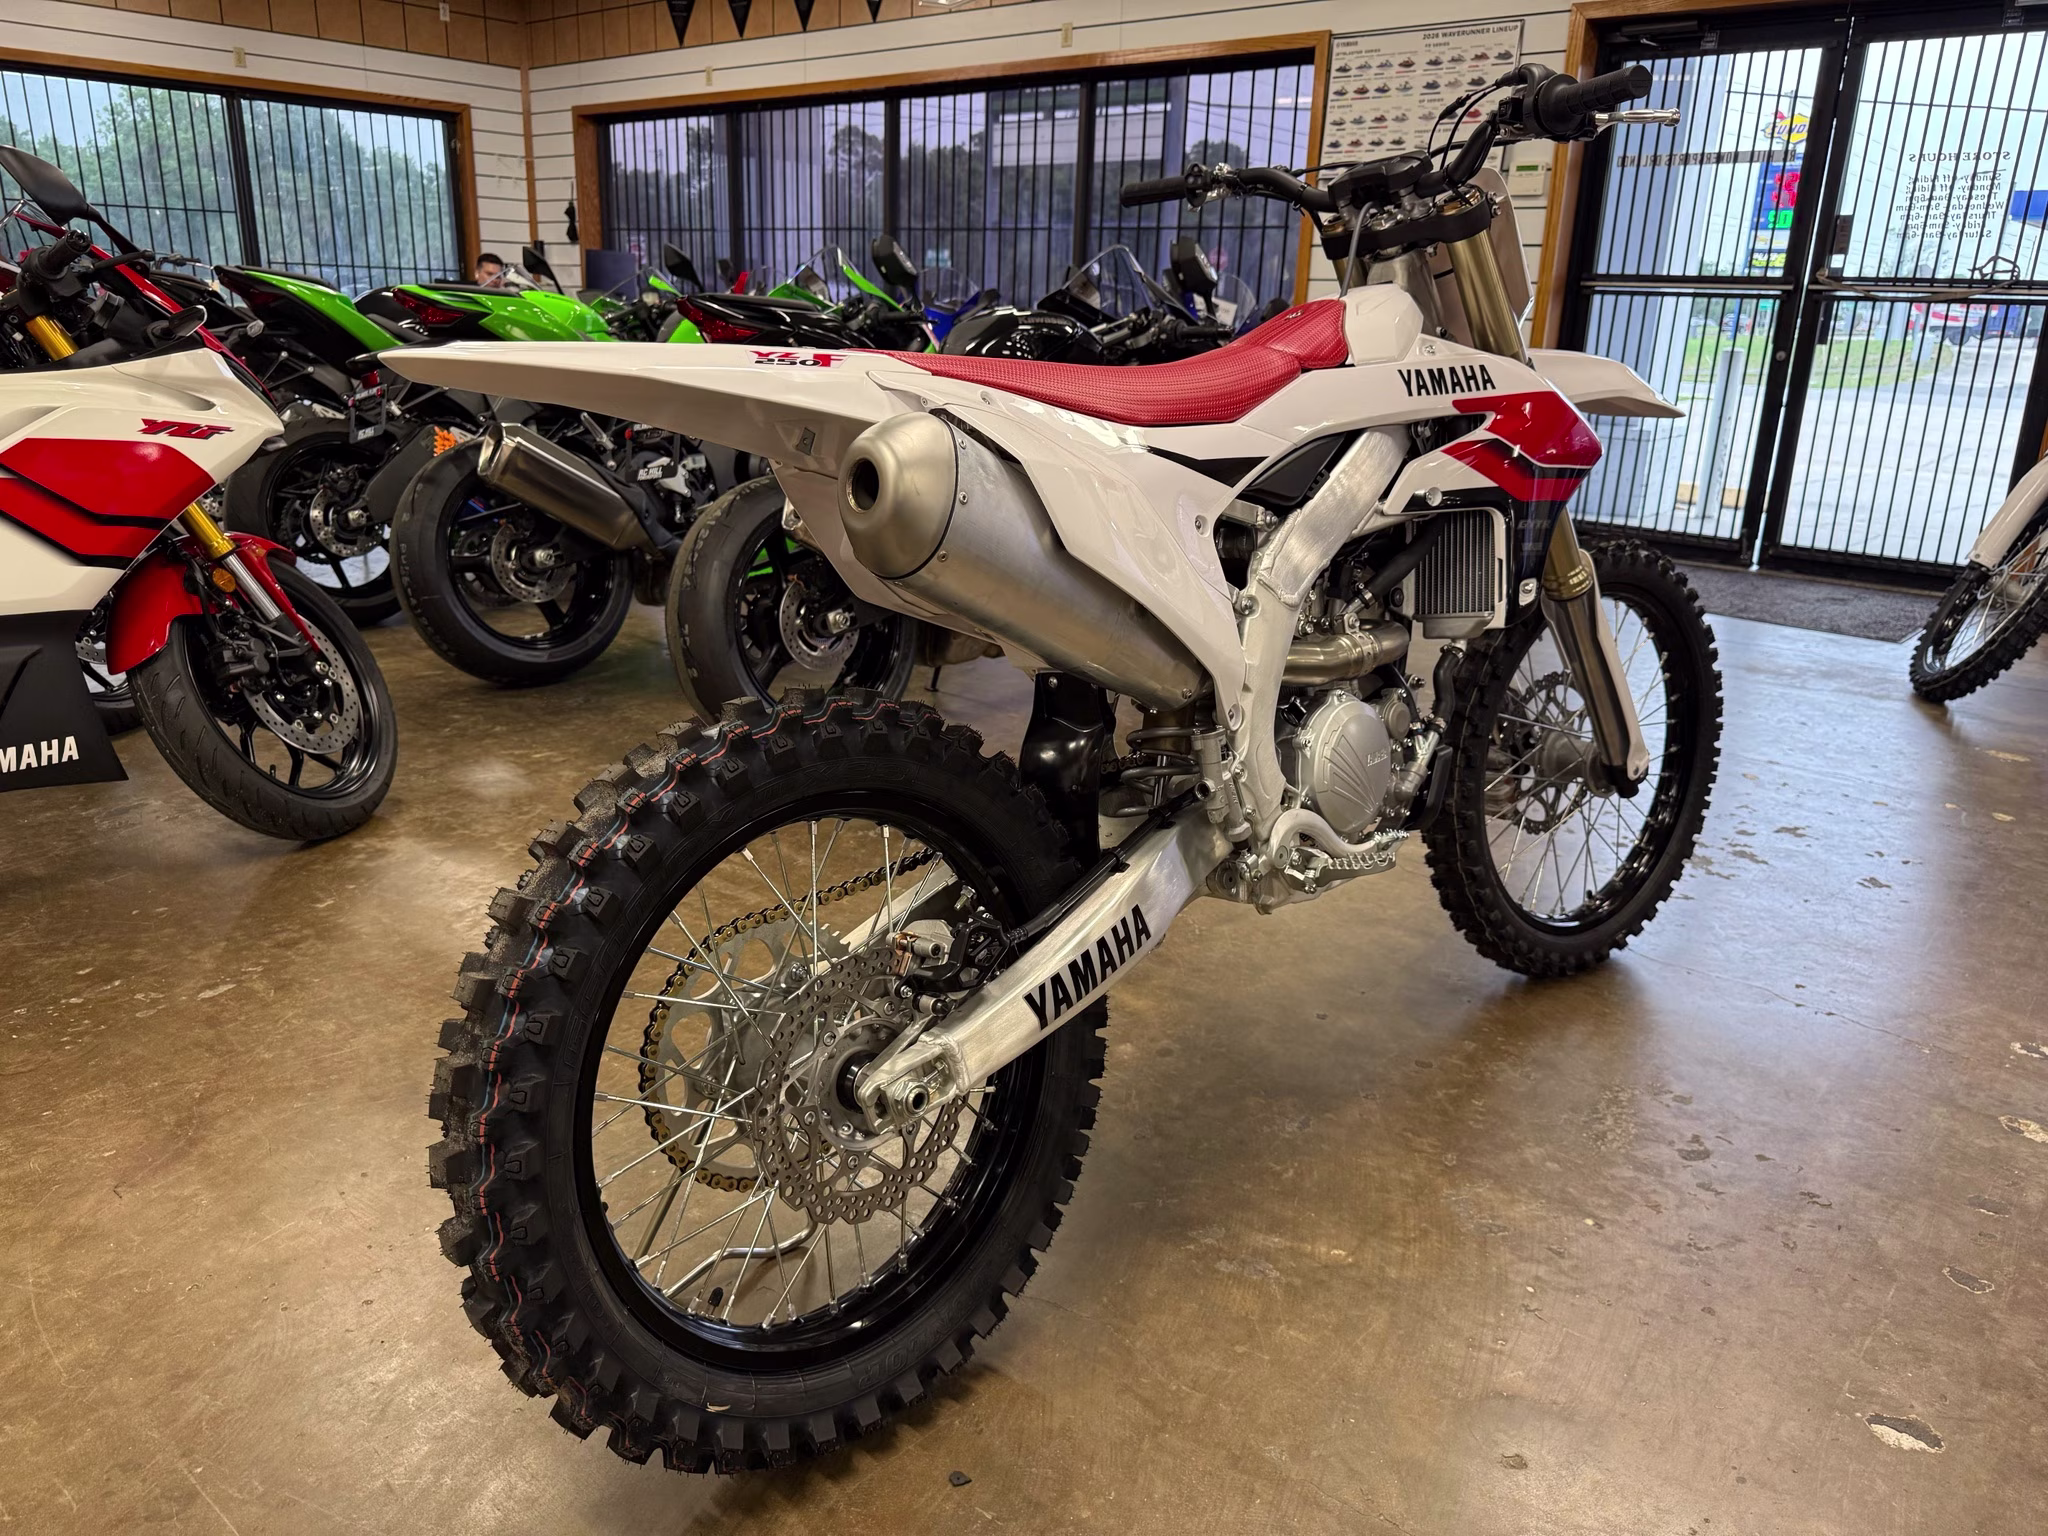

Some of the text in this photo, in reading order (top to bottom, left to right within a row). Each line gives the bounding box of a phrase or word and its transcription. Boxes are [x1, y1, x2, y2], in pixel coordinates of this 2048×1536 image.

[1441, 27, 1491, 38] WAVERUNNER
[1492, 24, 1519, 34] LINEUP
[749, 350, 800, 358] YZ
[1397, 364, 1496, 397] YAMAHA
[1023, 903, 1151, 1031] YAMAHA
